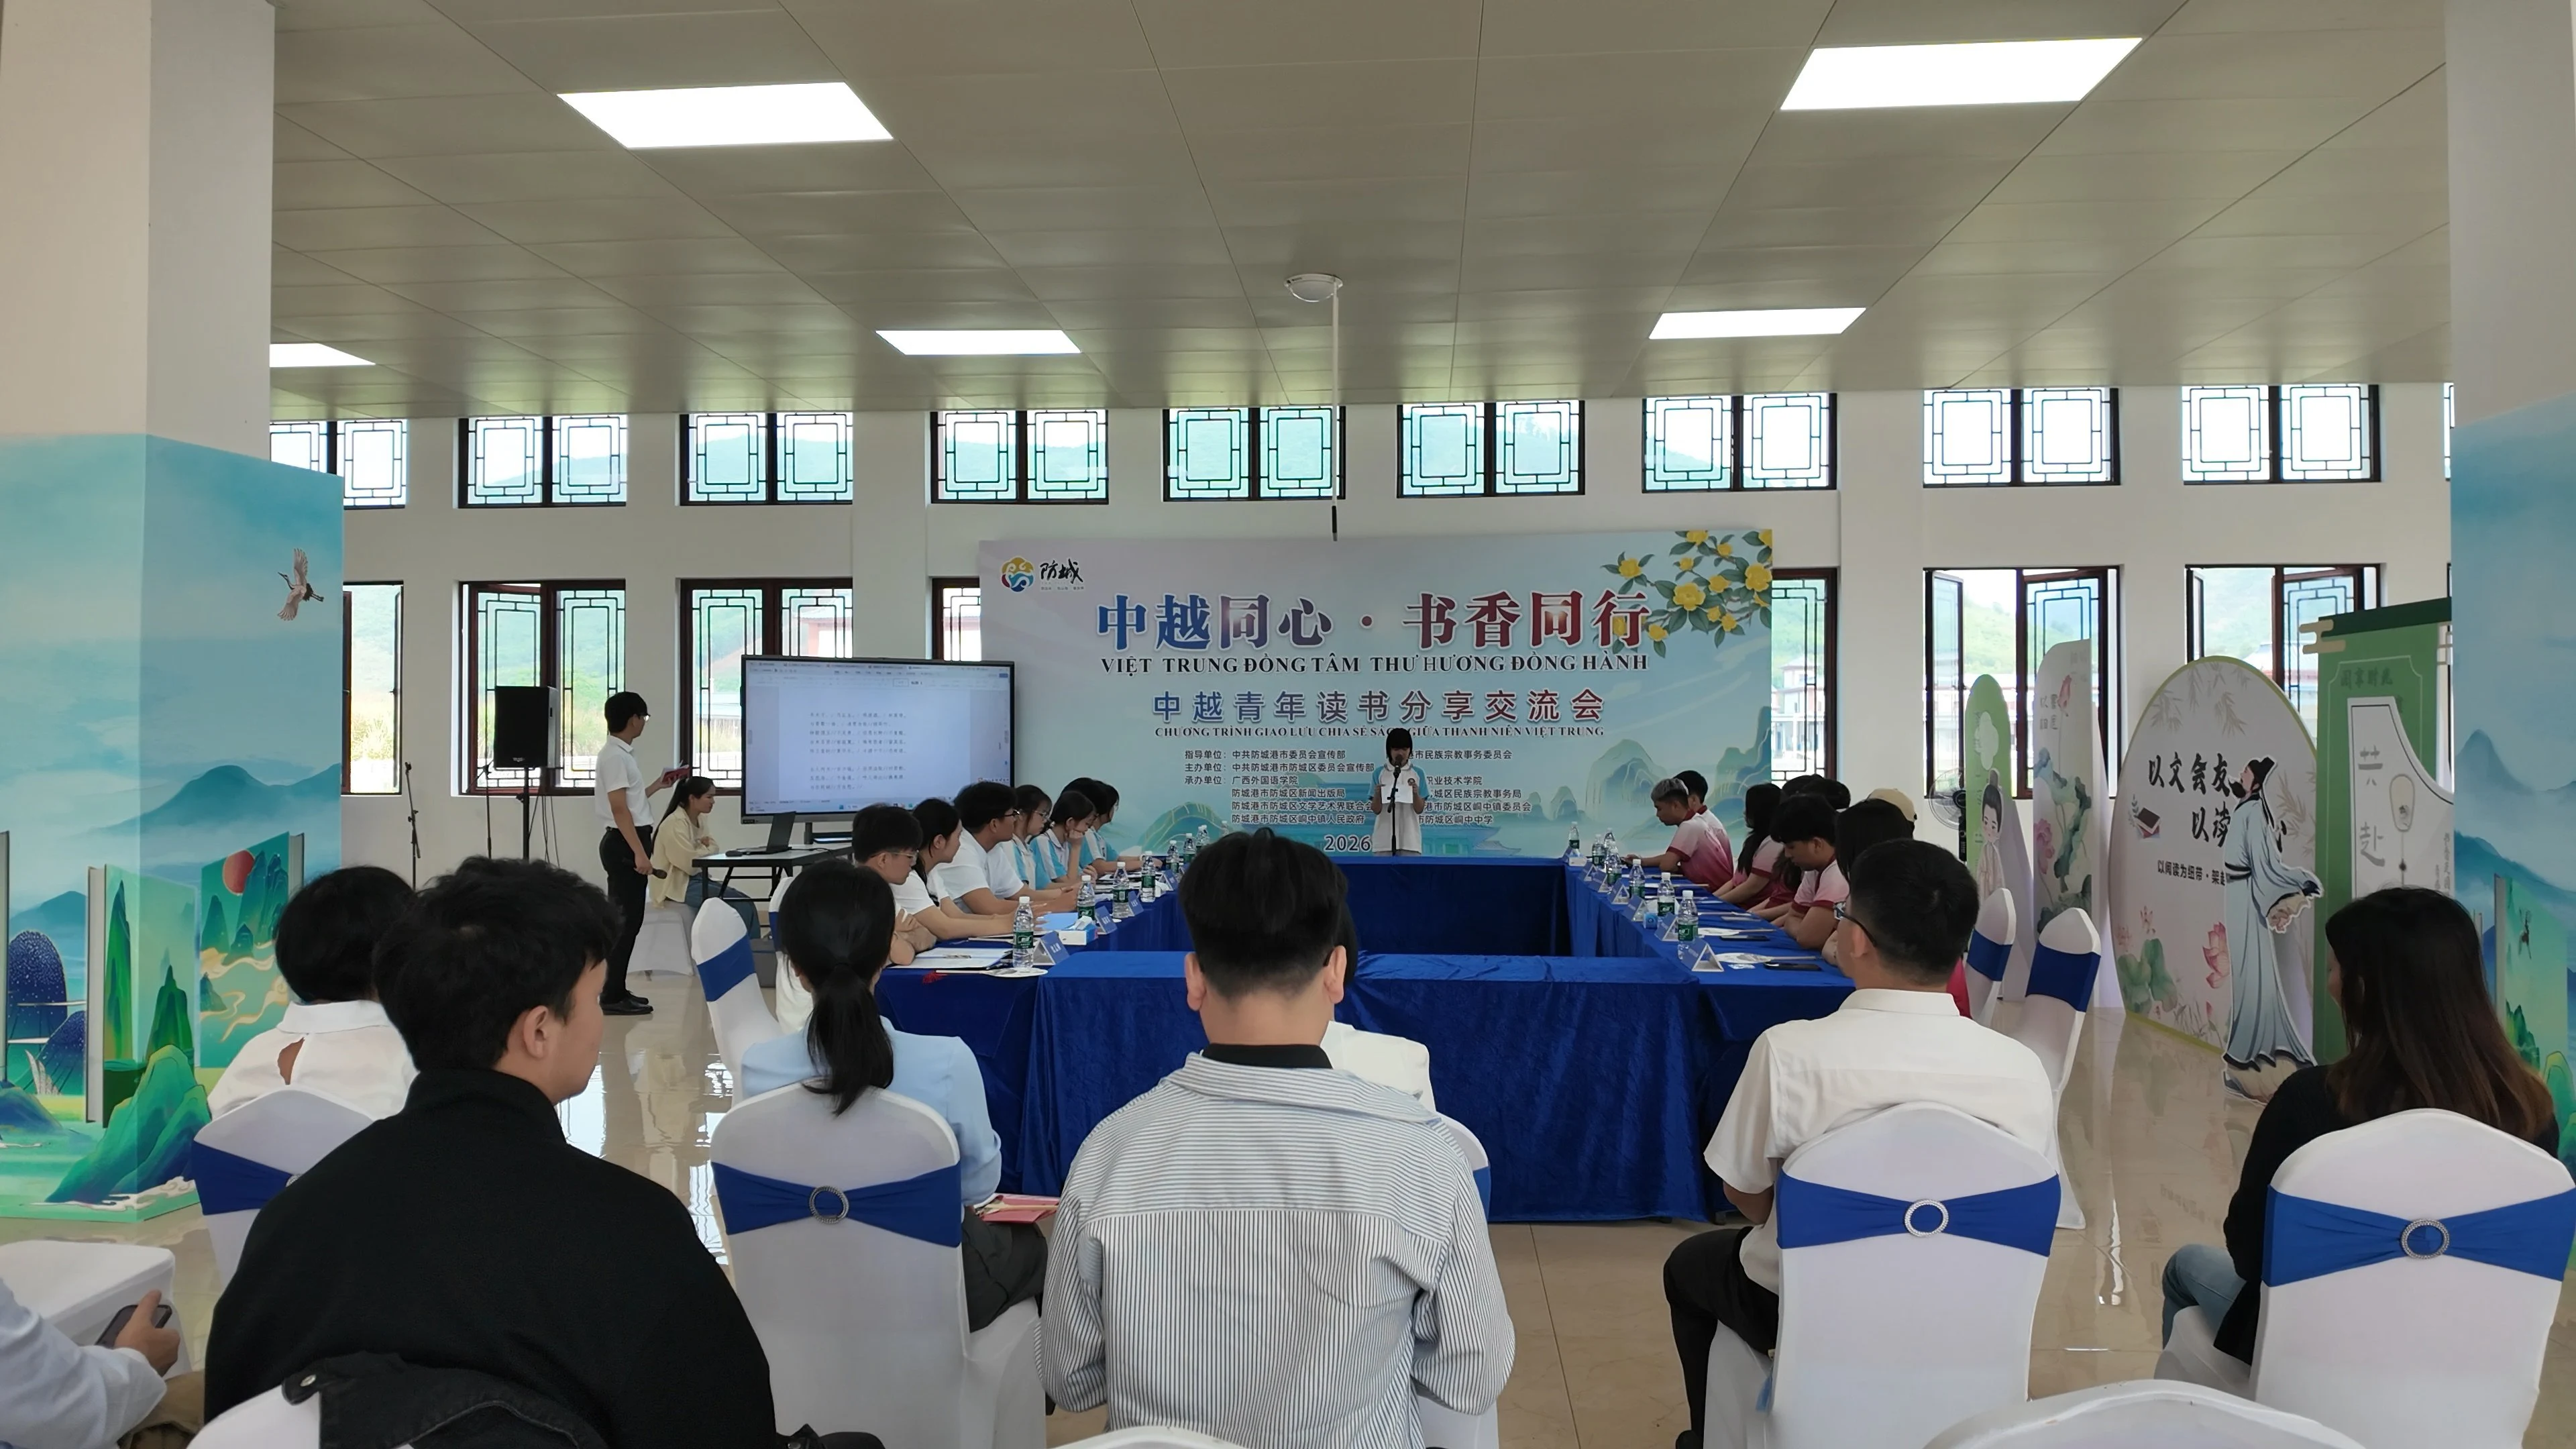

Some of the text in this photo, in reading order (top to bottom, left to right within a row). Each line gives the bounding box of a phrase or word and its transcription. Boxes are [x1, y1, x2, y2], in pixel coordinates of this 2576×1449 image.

[1039, 558, 1083, 584] 防城
[1101, 655, 1152, 676] VIỆT
[1163, 657, 1238, 673] TRUNG
[1311, 653, 1359, 673] TÂM
[1370, 654, 1419, 672] THƯ
[1424, 653, 1504, 672] HƯƠNG
[1582, 650, 1647, 670] HÀNH
[1154, 689, 1603, 722] 中越青年读书分享交流会
[1155, 727, 1210, 737] CHƯƠNG
[1213, 725, 1251, 737] TRÌNH
[1255, 727, 1287, 737] GIAO
[1290, 727, 1316, 737] LƯU
[1319, 727, 1350, 737] CHIA
[1371, 724, 1397, 737] SÁ
[1442, 727, 1487, 737] THANH
[1558, 727, 1604, 737] TRUNG
[2148, 751, 2231, 797] 以文会友
[1232, 788, 1345, 798] 防城港市防城区新闻出版局
[1431, 789, 1521, 798] 城区民族宗教事务局
[1232, 814, 1364, 824] 防城港市防城区峒中镇人民政府
[1325, 836, 1371, 851] 2026
